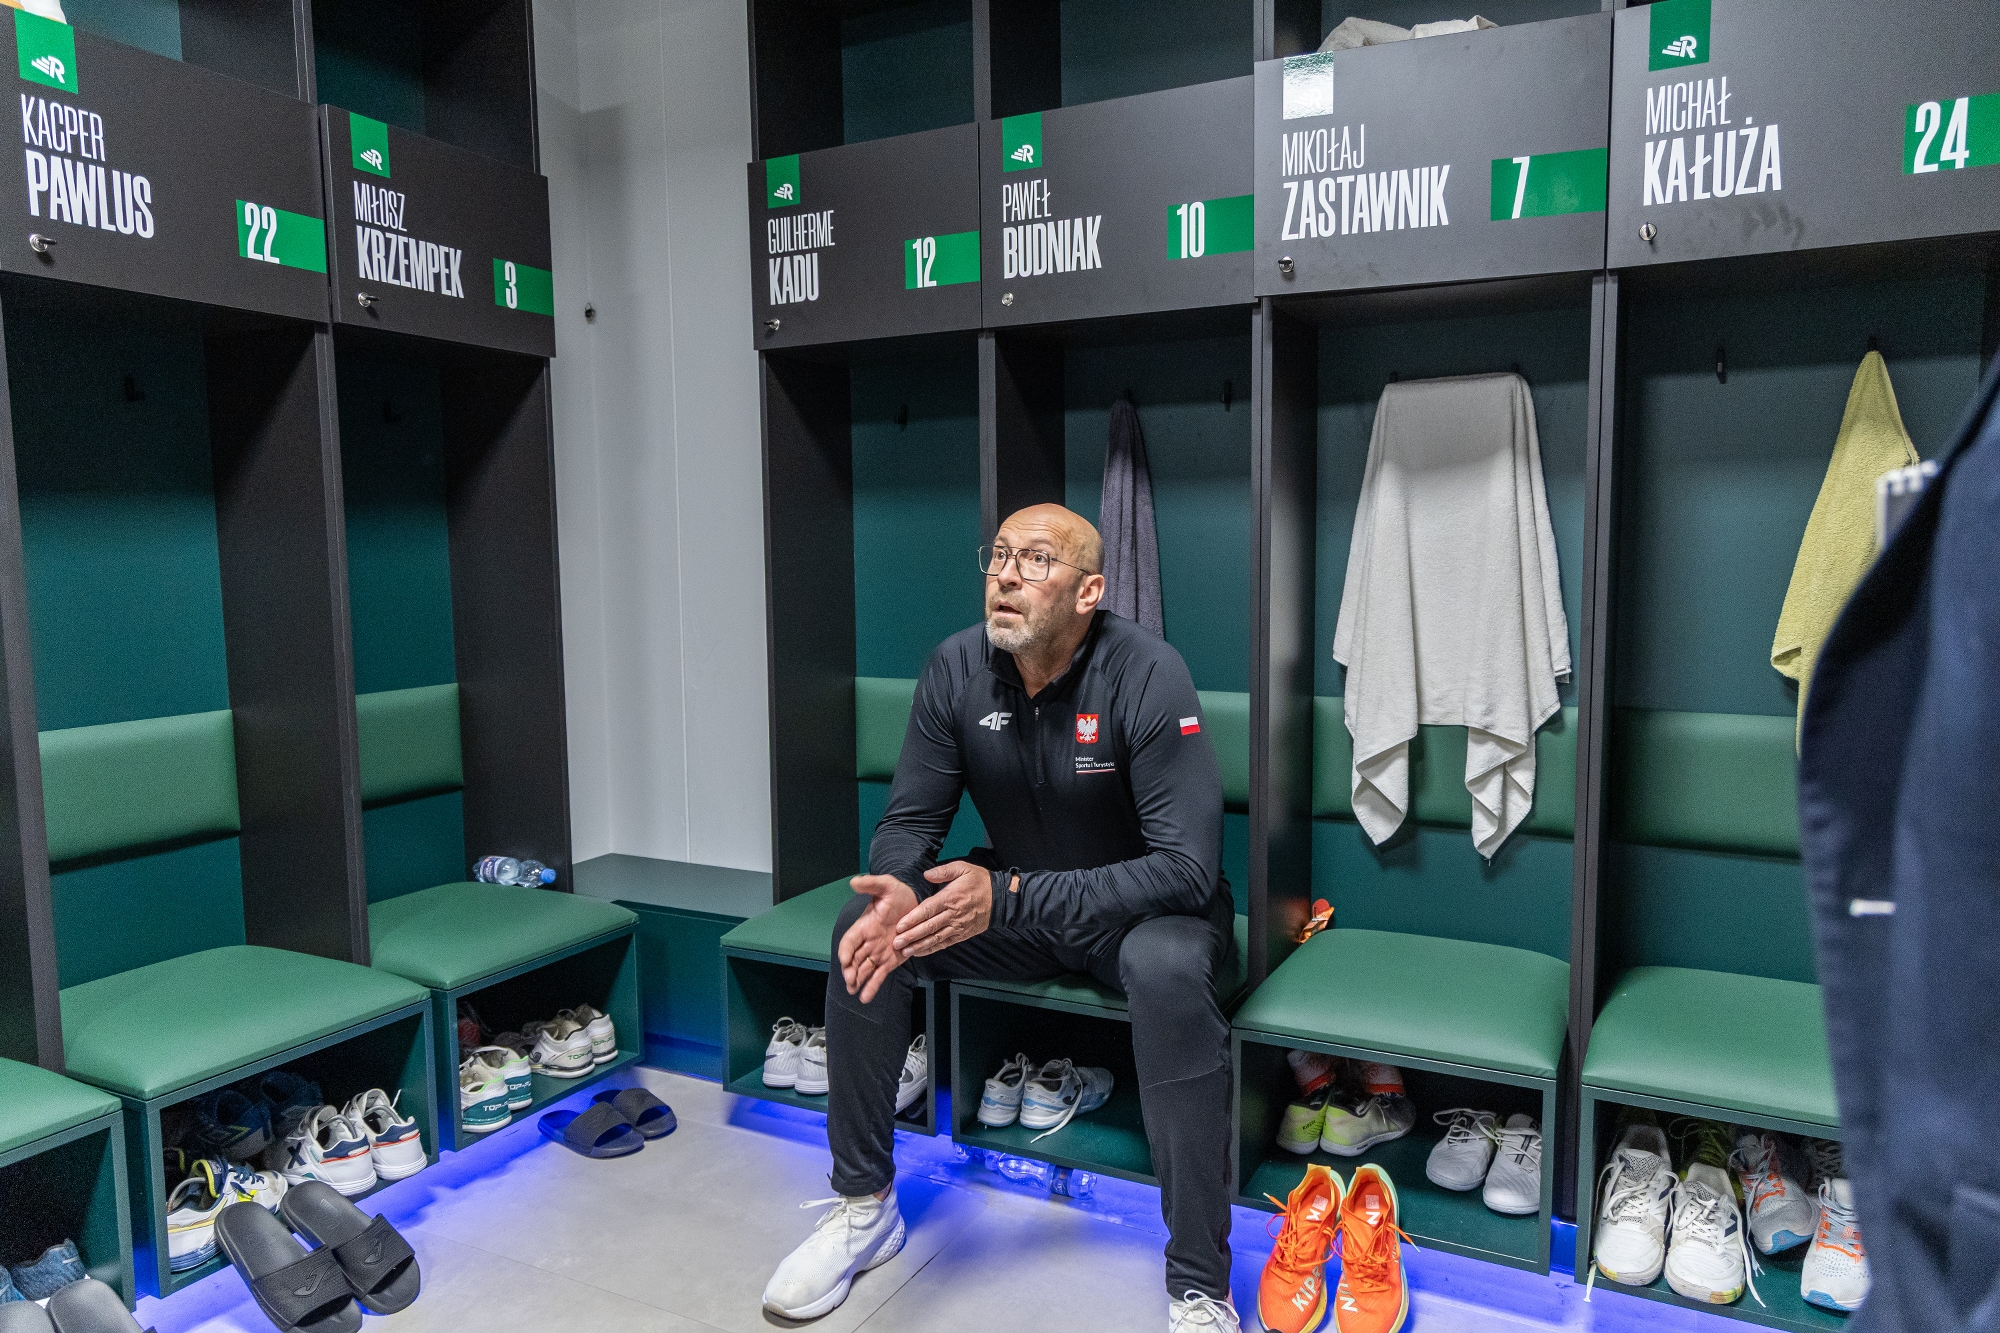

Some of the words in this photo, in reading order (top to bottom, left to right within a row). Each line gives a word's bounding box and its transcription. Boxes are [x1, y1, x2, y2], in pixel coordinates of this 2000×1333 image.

[20, 93, 106, 162] KACPER
[1645, 75, 1733, 136] MICHAŁ
[1913, 96, 1970, 174] 24
[1281, 121, 1366, 178] MIKOŁAJ
[1642, 116, 1782, 207] KAŁUŻA
[25, 148, 155, 239] PAWLUS
[353, 180, 408, 232] MIŁOSZ
[1002, 178, 1052, 223] PAWEŁ
[1280, 163, 1451, 242] ZASTAWNIK
[1511, 155, 1531, 220] 7
[244, 202, 280, 265] 22
[767, 209, 836, 254] GUILHERME
[1003, 214, 1102, 279] BUDNIAK
[1176, 201, 1205, 259] 10
[356, 225, 465, 299] KRZEMPEK
[504, 261, 518, 309] 3
[769, 252, 819, 306] KADU
[912, 236, 937, 288] 12
[978, 711, 1013, 731] 4F
